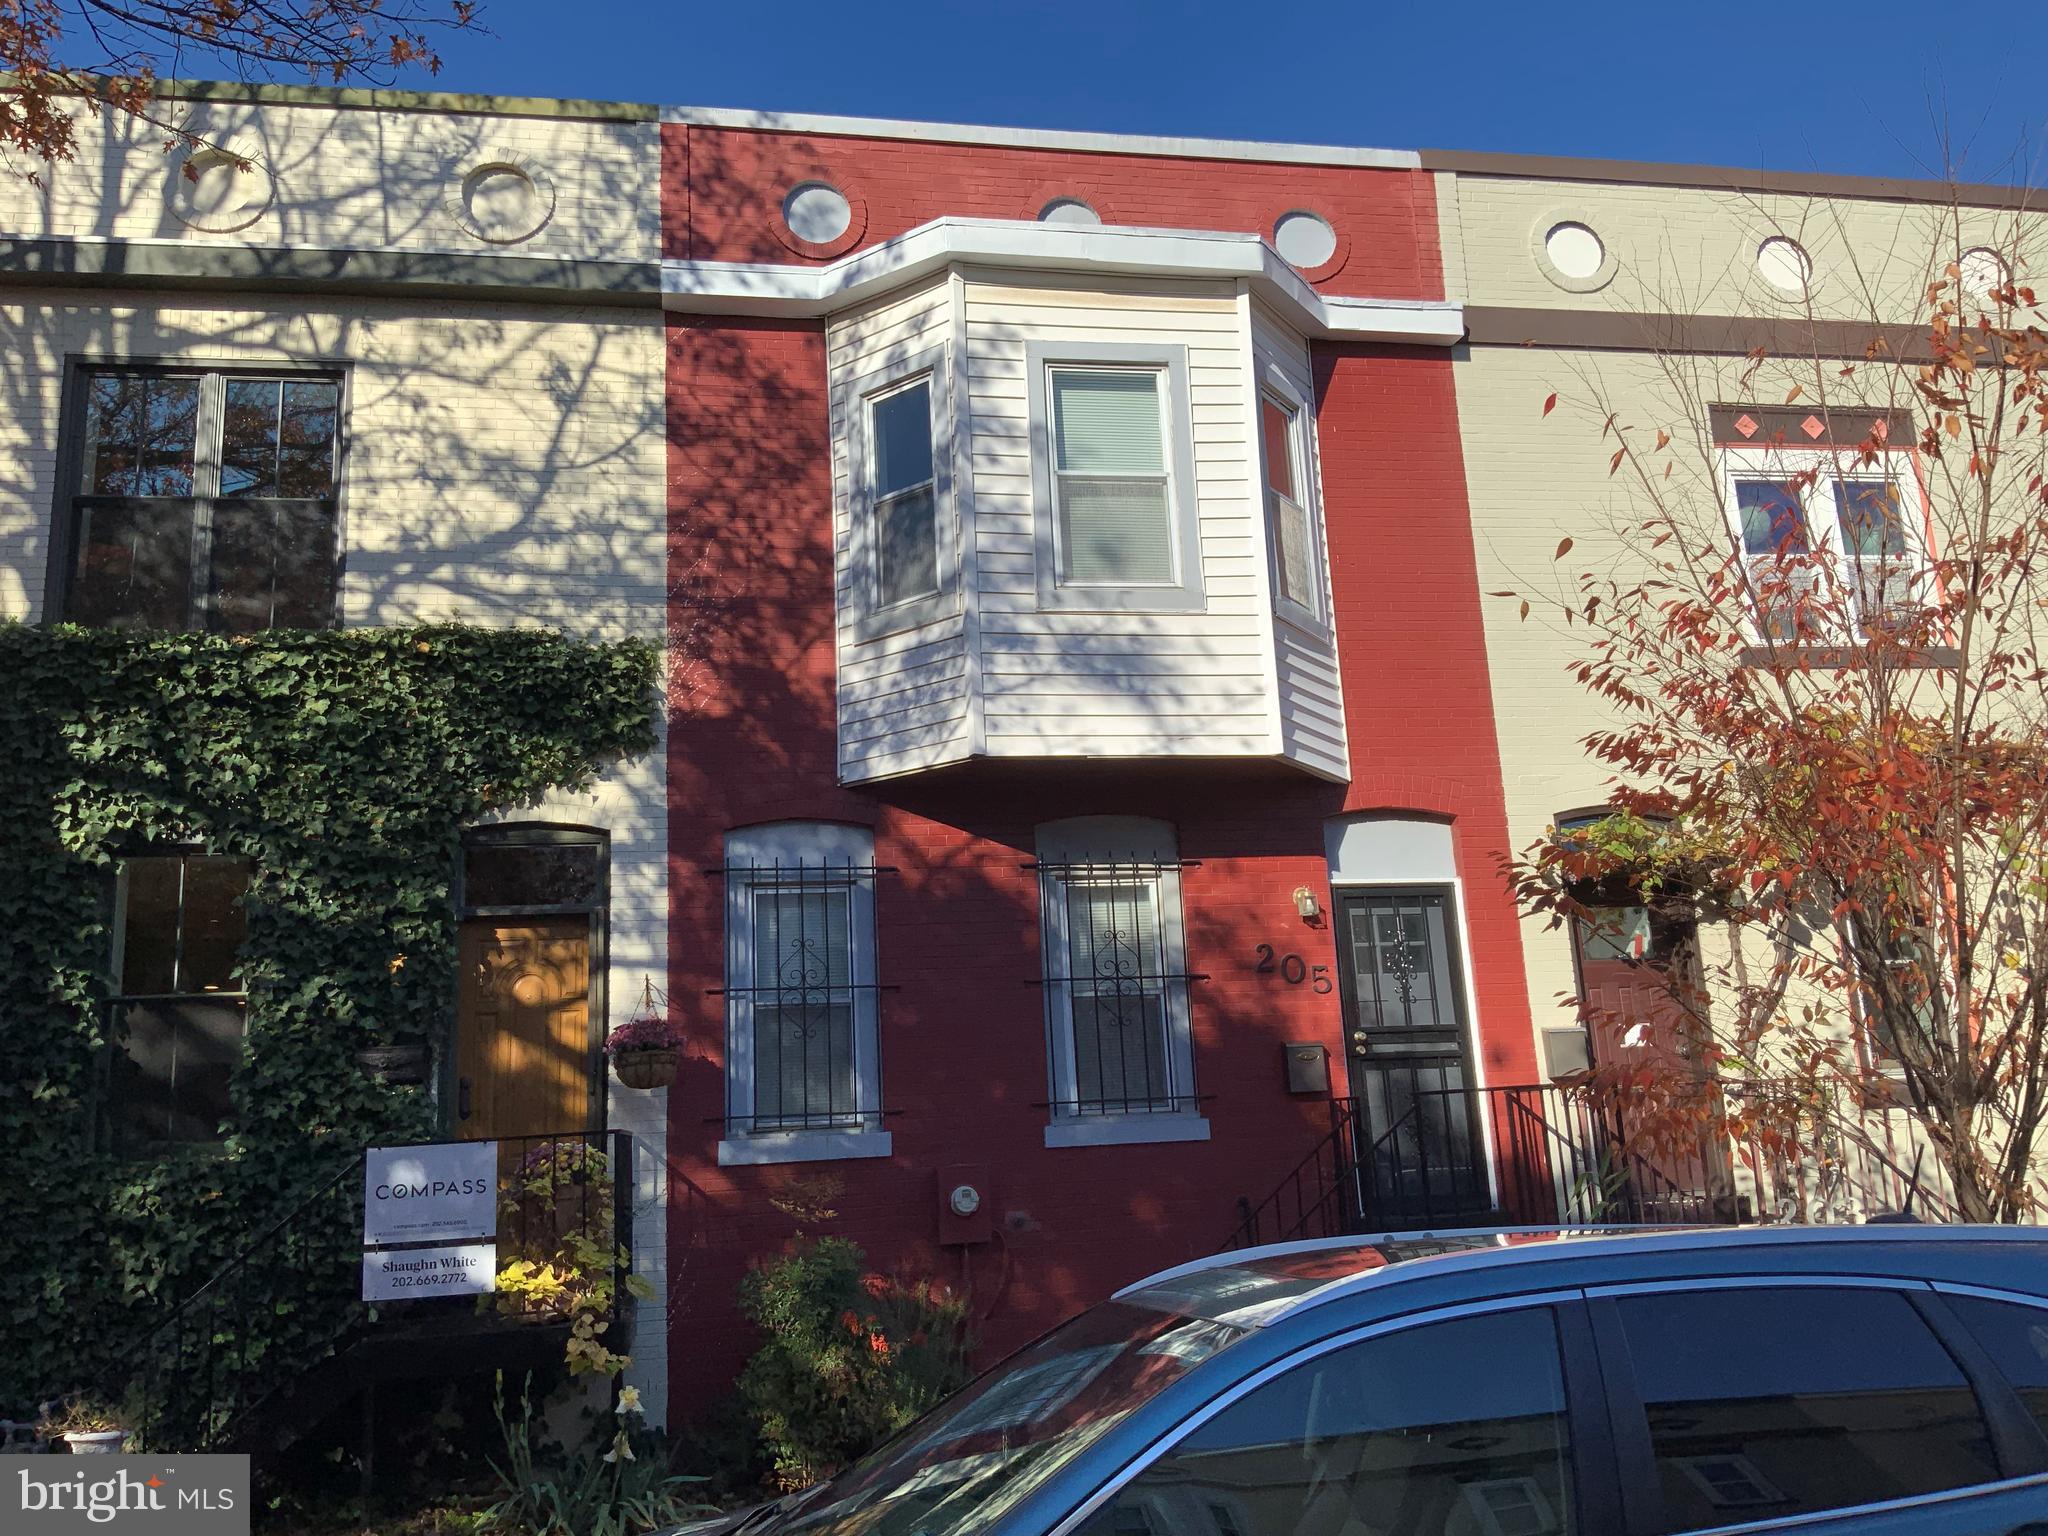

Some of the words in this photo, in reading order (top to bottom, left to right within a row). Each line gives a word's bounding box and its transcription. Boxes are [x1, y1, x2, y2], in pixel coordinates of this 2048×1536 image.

[1256, 943, 1333, 994] 205
[375, 1179, 487, 1200] COMPASS
[382, 1258, 437, 1273] Shaughn
[440, 1256, 477, 1268] White
[391, 1272, 468, 1288] 202.669.2772
